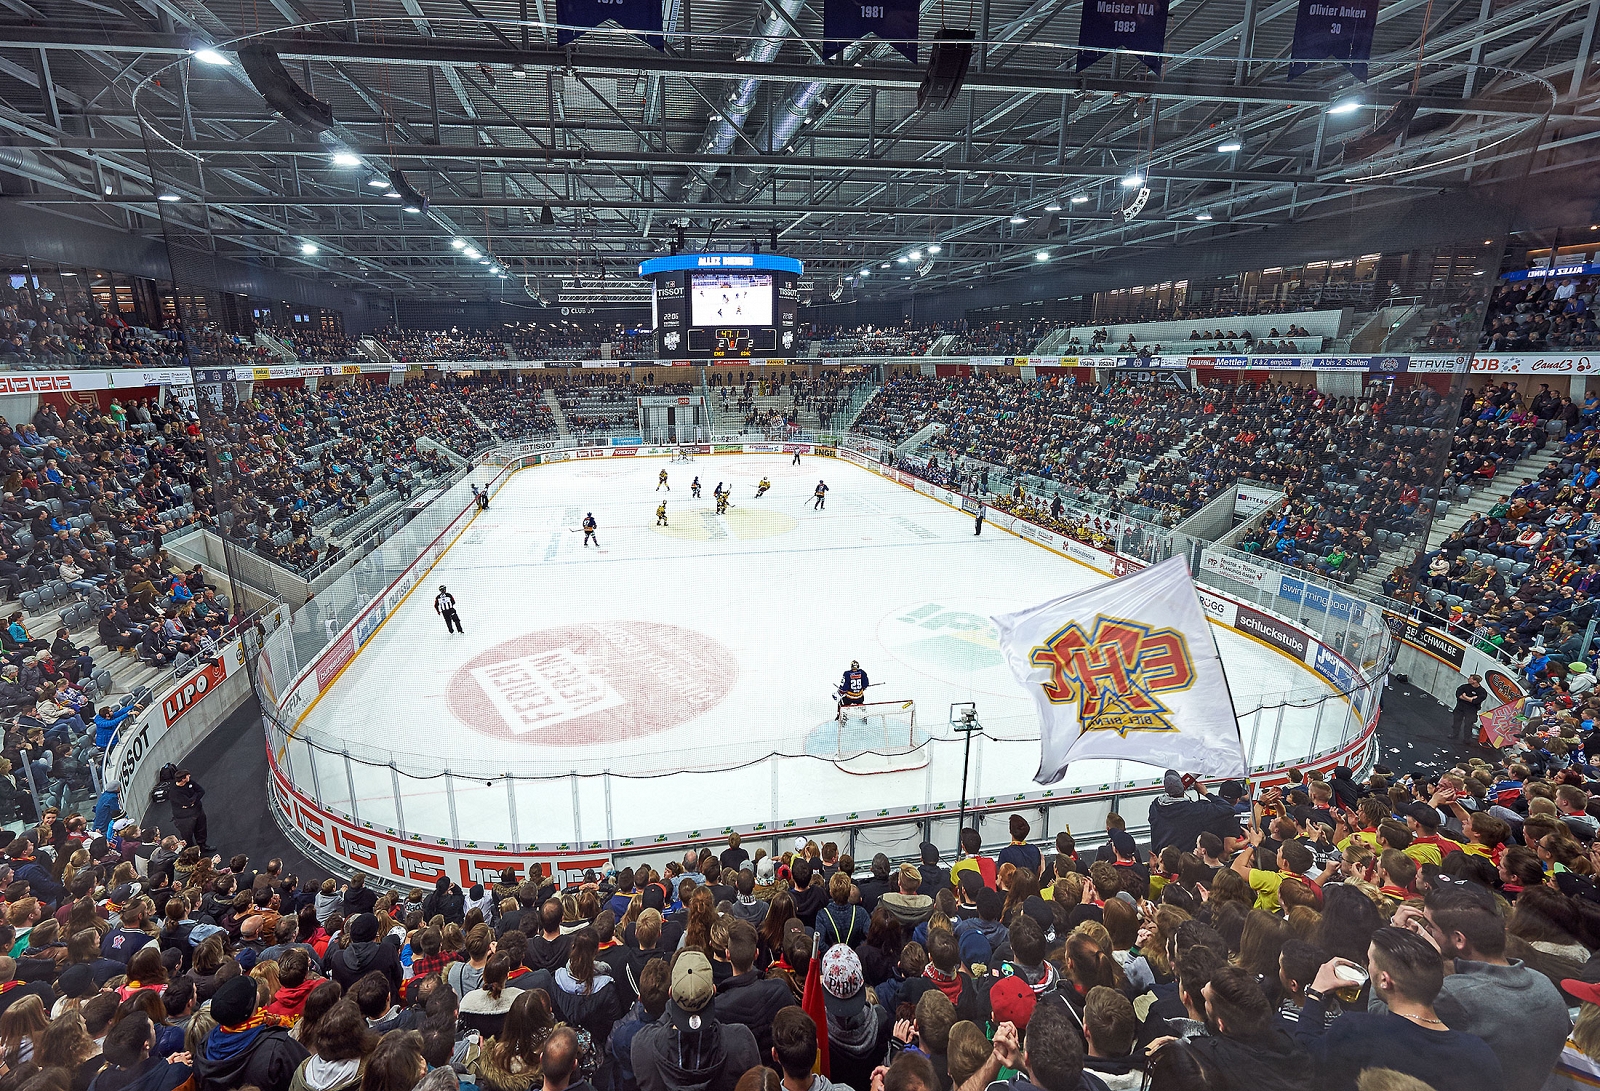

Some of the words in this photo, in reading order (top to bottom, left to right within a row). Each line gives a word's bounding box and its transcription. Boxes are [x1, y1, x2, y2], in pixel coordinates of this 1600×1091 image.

[861, 6, 884, 19] 1981
[1096, 1, 1135, 14] Meister
[1137, 3, 1154, 16] NLA
[1309, 4, 1338, 16] Olivier
[1339, 6, 1366, 19] Anken
[1114, 20, 1136, 33] 1983
[1330, 23, 1342, 35] 30
[657, 287, 685, 297] TISSOT
[778, 287, 798, 297] TISSOT
[719, 339, 725, 349] 2
[748, 339, 754, 349] 2
[1271, 359, 1293, 369] emplois
[1409, 360, 1455, 369] ETAVIS
[1472, 359, 1499, 370] RJB
[529, 442, 556, 451] TISSOT
[1240, 615, 1303, 652] schluckstube
[1420, 632, 1457, 657] SCHWALBE
[165, 674, 208, 721] LIPO
[829, 974, 861, 995] PARIS
